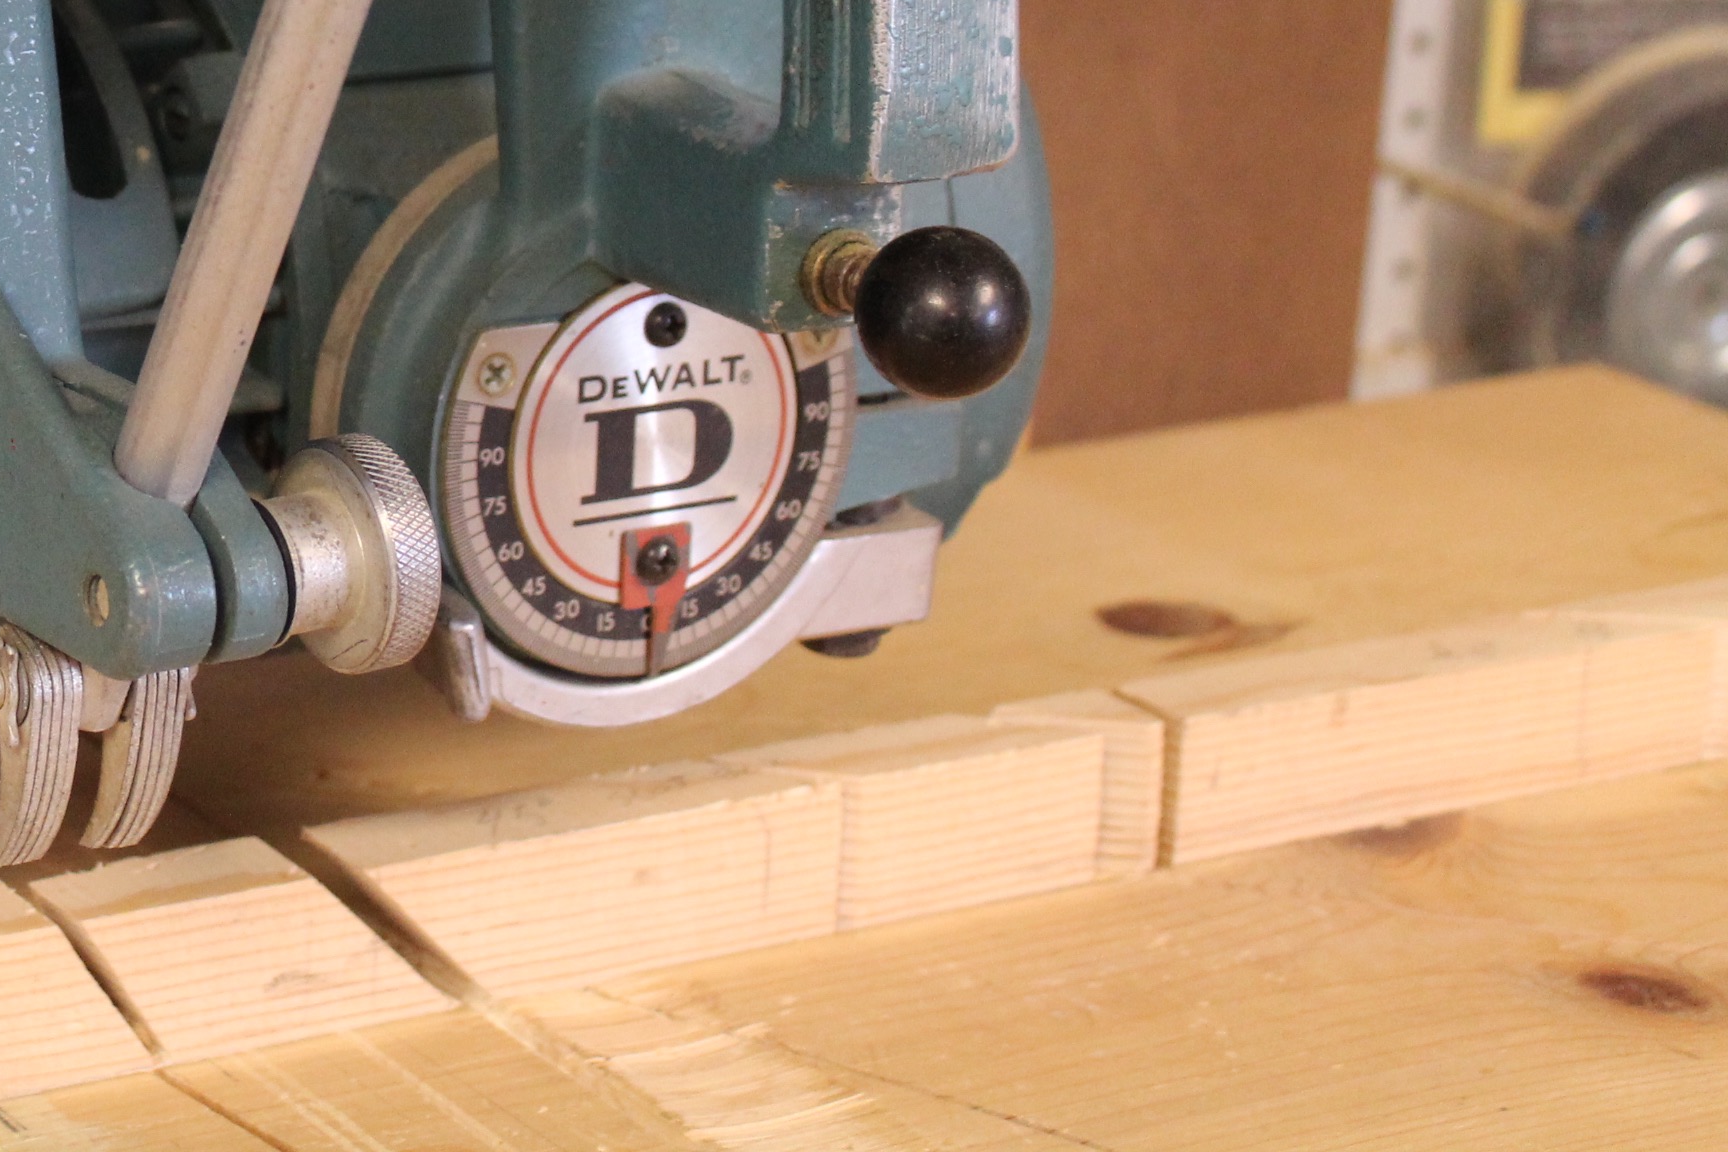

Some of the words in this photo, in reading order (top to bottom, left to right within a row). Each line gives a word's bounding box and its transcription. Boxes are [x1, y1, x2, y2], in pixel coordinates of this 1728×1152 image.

[804, 401, 829, 421] 90
[480, 447, 505, 466] 90
[581, 399, 734, 505] D
[797, 451, 820, 471] 75
[483, 496, 507, 516] 75
[776, 500, 802, 519] 60
[497, 542, 524, 562] 60
[748, 541, 772, 561] 45
[521, 576, 547, 597] 45
[716, 574, 742, 594] 30
[553, 599, 580, 620] 30
[681, 599, 700, 619] 15
[597, 613, 616, 632] 15
